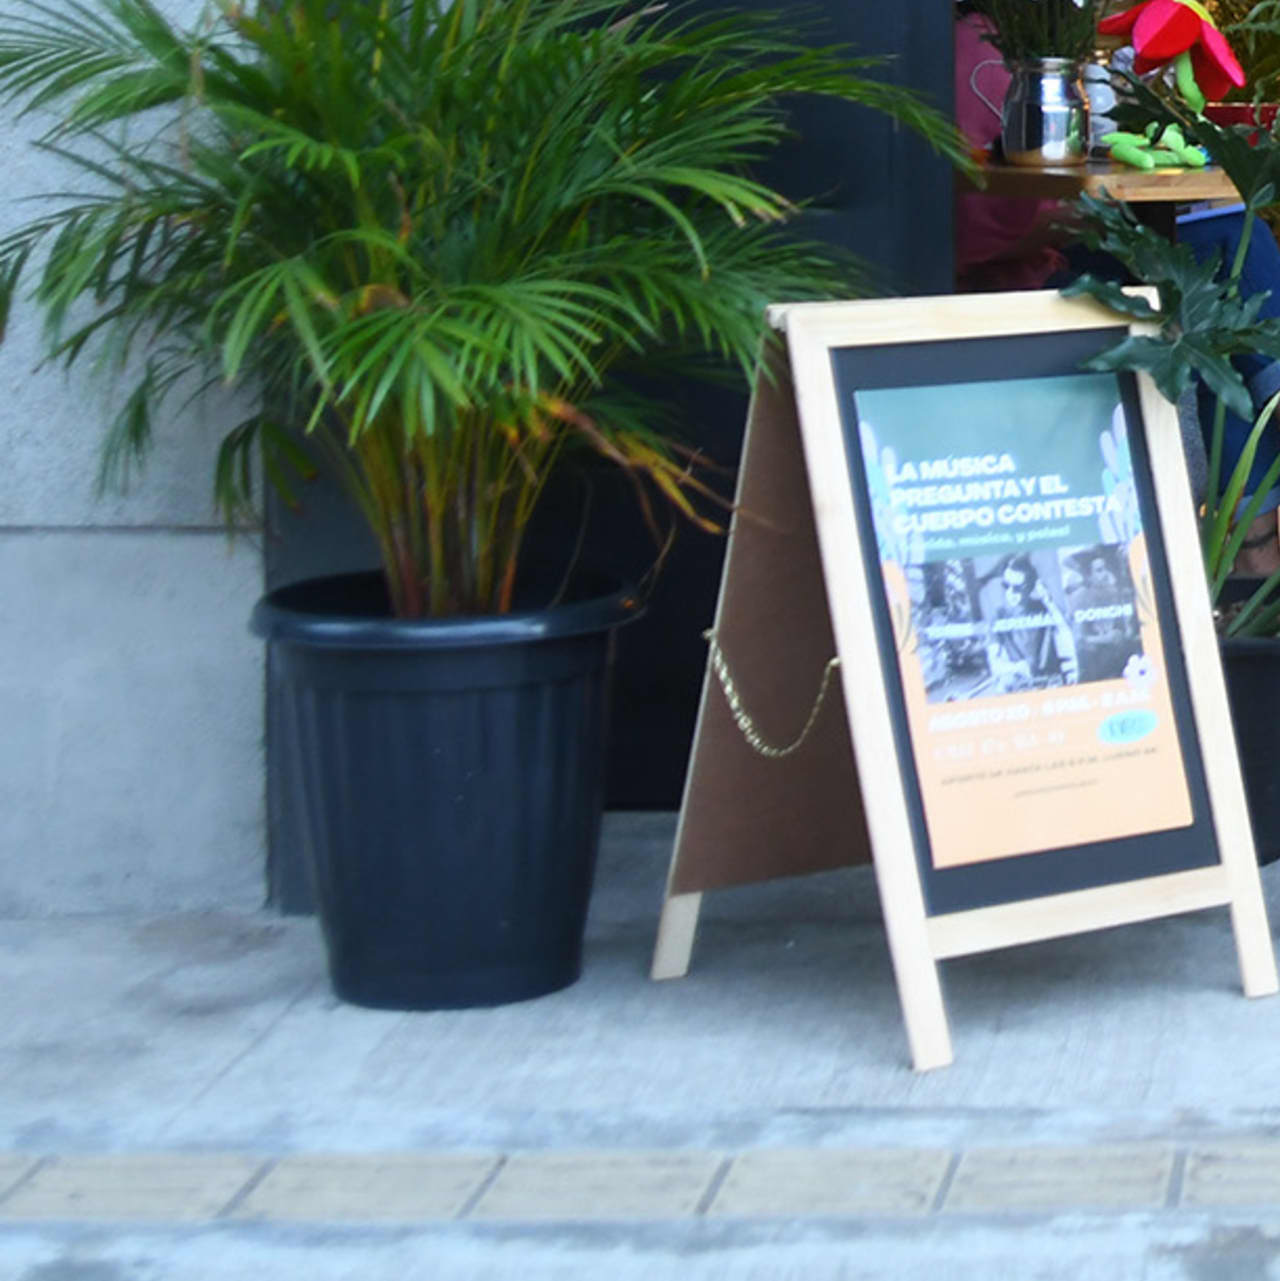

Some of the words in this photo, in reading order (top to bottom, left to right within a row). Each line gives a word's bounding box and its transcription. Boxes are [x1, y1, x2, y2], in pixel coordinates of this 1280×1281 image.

[886, 462, 918, 483] LA
[920, 454, 1016, 480] MÚSICA
[891, 478, 1021, 507] PREGUNTA
[1019, 476, 1037, 496] Y
[1039, 474, 1069, 495] EL
[893, 505, 994, 534] CUERPO
[998, 495, 1124, 525] CONTESTA
